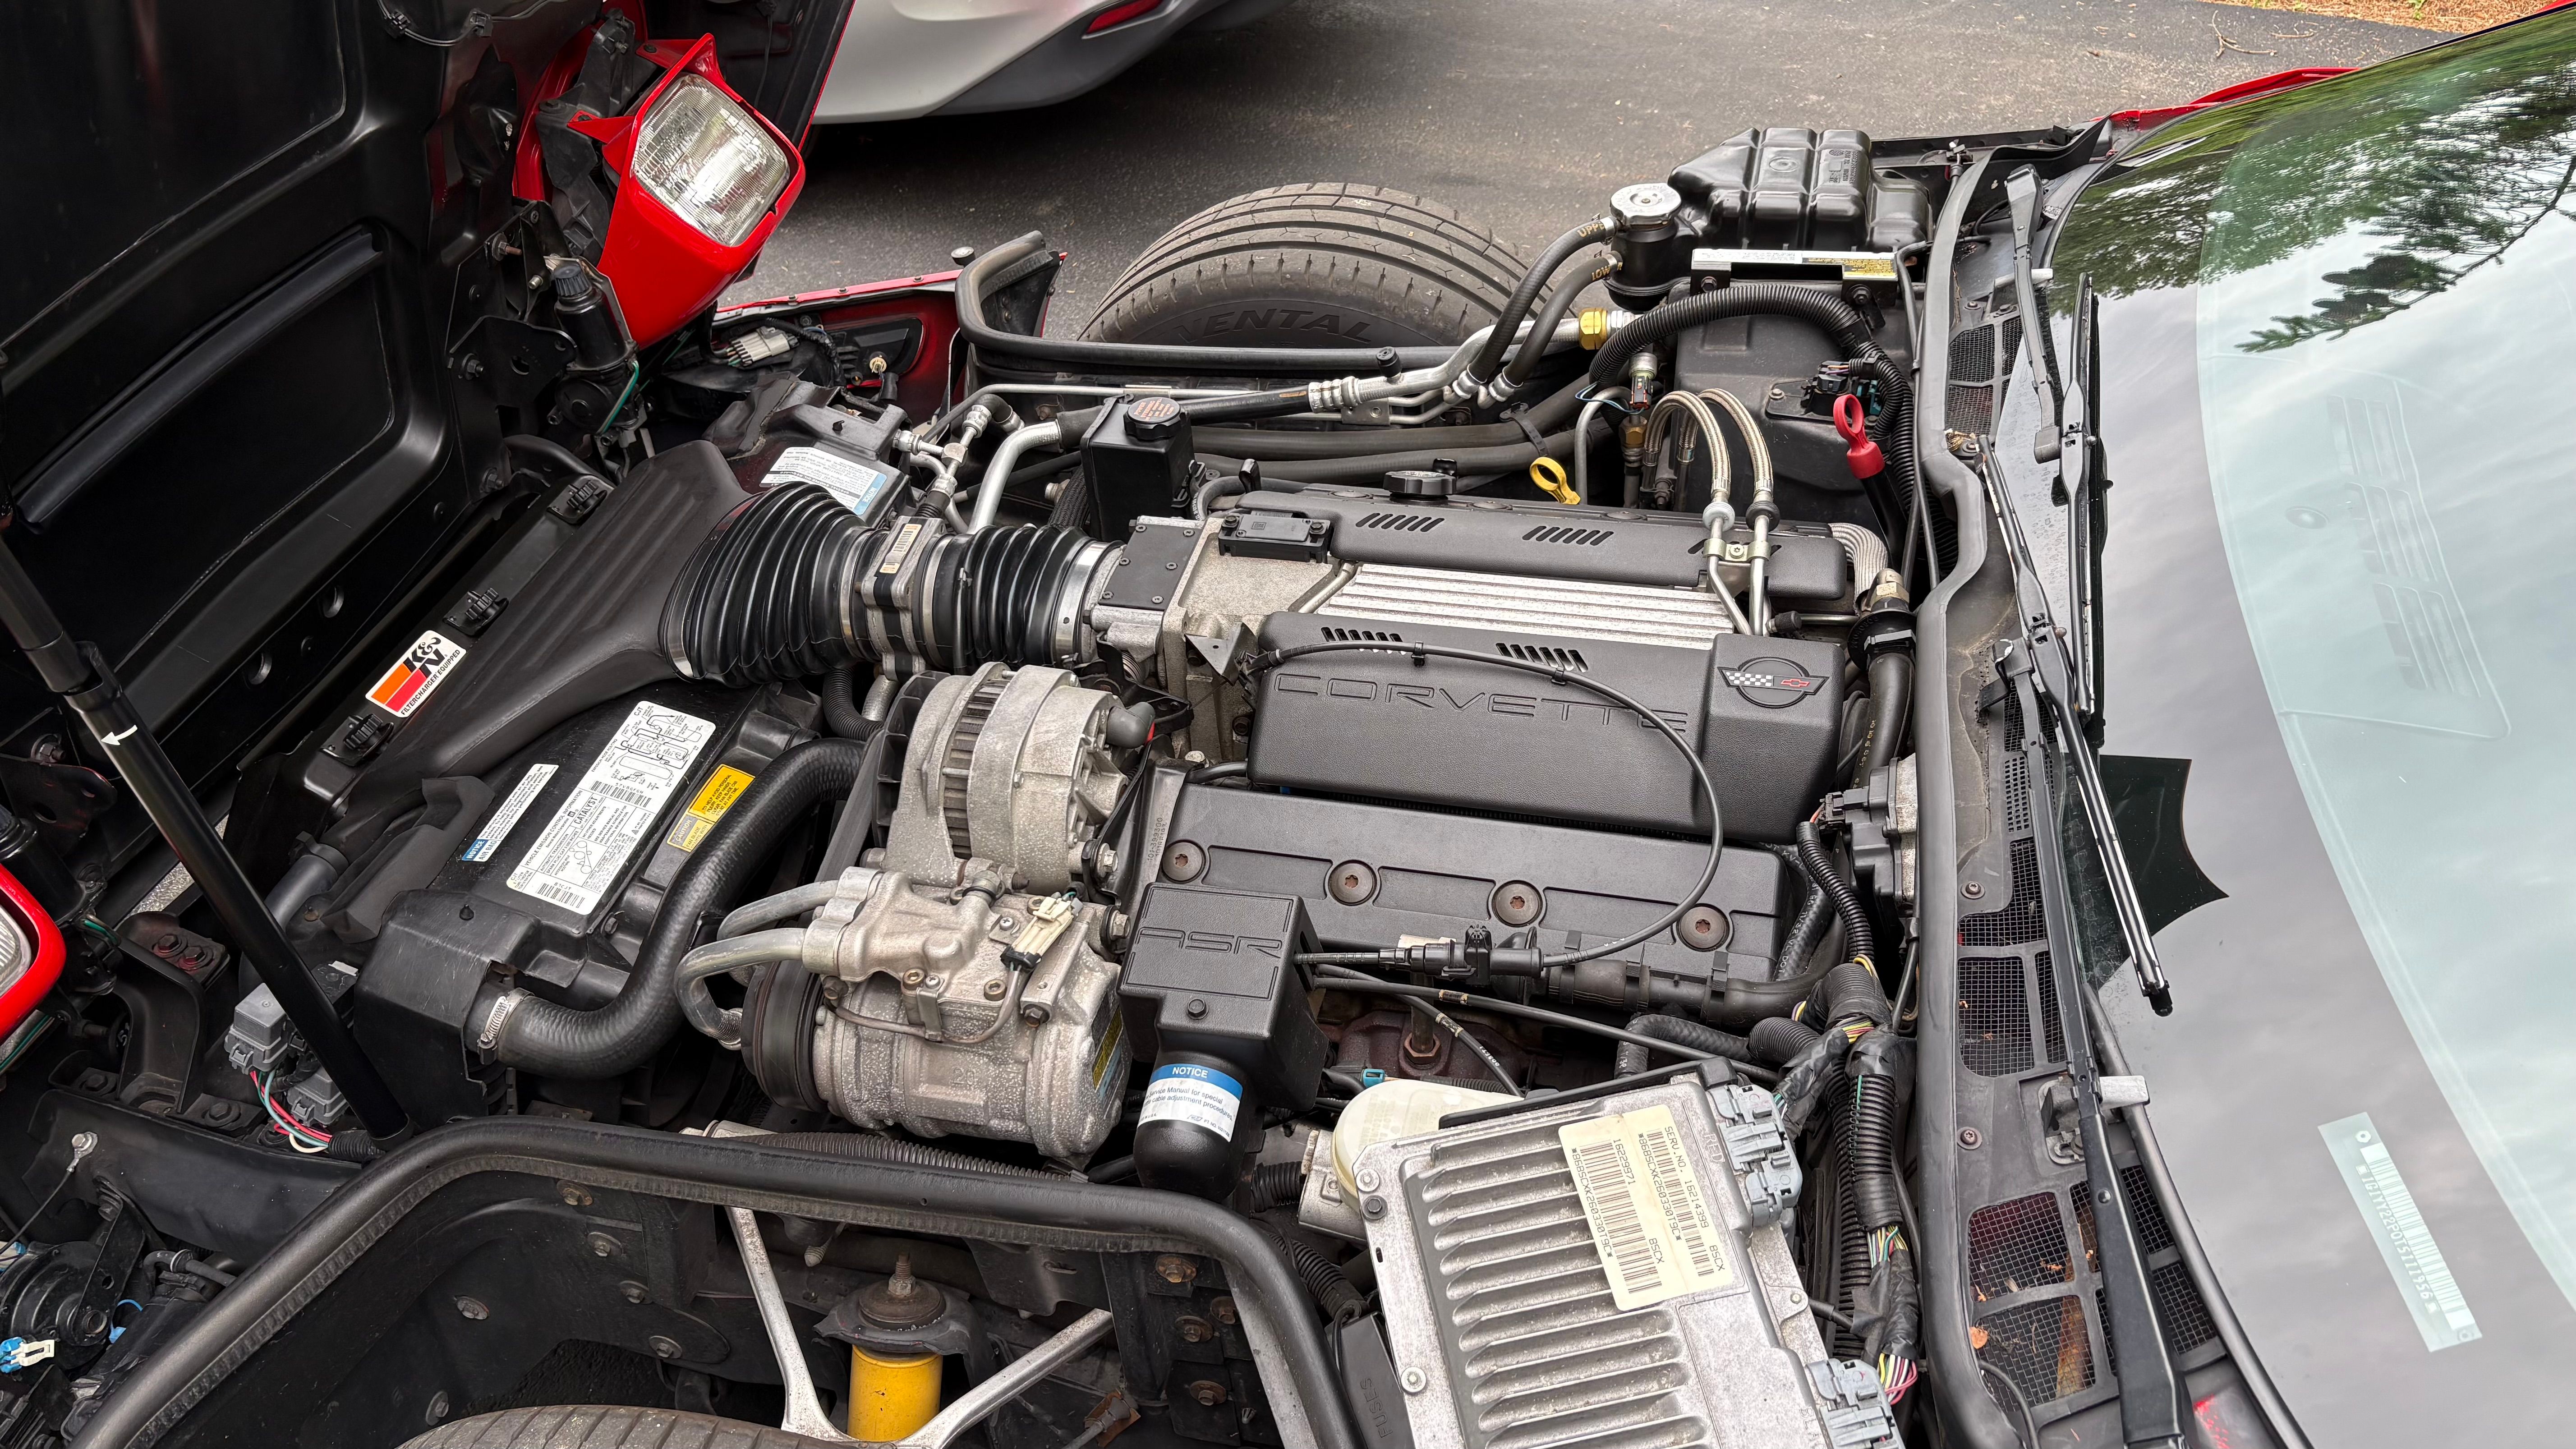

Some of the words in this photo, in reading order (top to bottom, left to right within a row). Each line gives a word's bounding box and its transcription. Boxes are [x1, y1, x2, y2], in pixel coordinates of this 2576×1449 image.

[1592, 262, 1623, 281] LOWR
[401, 674, 438, 715] FILTERCHARGER
[437, 649, 460, 675] EQUIPPED
[1274, 673, 1688, 734] CORVETTE
[574, 796, 597, 824] CATALYST
[524, 850, 539, 865] VEHICLE
[536, 832, 552, 850] EMISSION
[550, 815, 565, 832] CONTROL
[562, 790, 582, 814] INFORMATION
[675, 819, 692, 842] CAUTION
[465, 840, 486, 859] NOTICE
[478, 851, 489, 860] AIR
[485, 841, 497, 850] BAG
[1135, 926, 1283, 959] ASR
[1172, 1066, 1208, 1078] NOTICE
[1167, 1094, 1201, 1104] adjustment
[1201, 1092, 1223, 1105] special
[1613, 1139, 1635, 1184] 16229971
[1684, 1180, 1709, 1228] 16214399
[1360, 1378, 1393, 1438] FUSES
